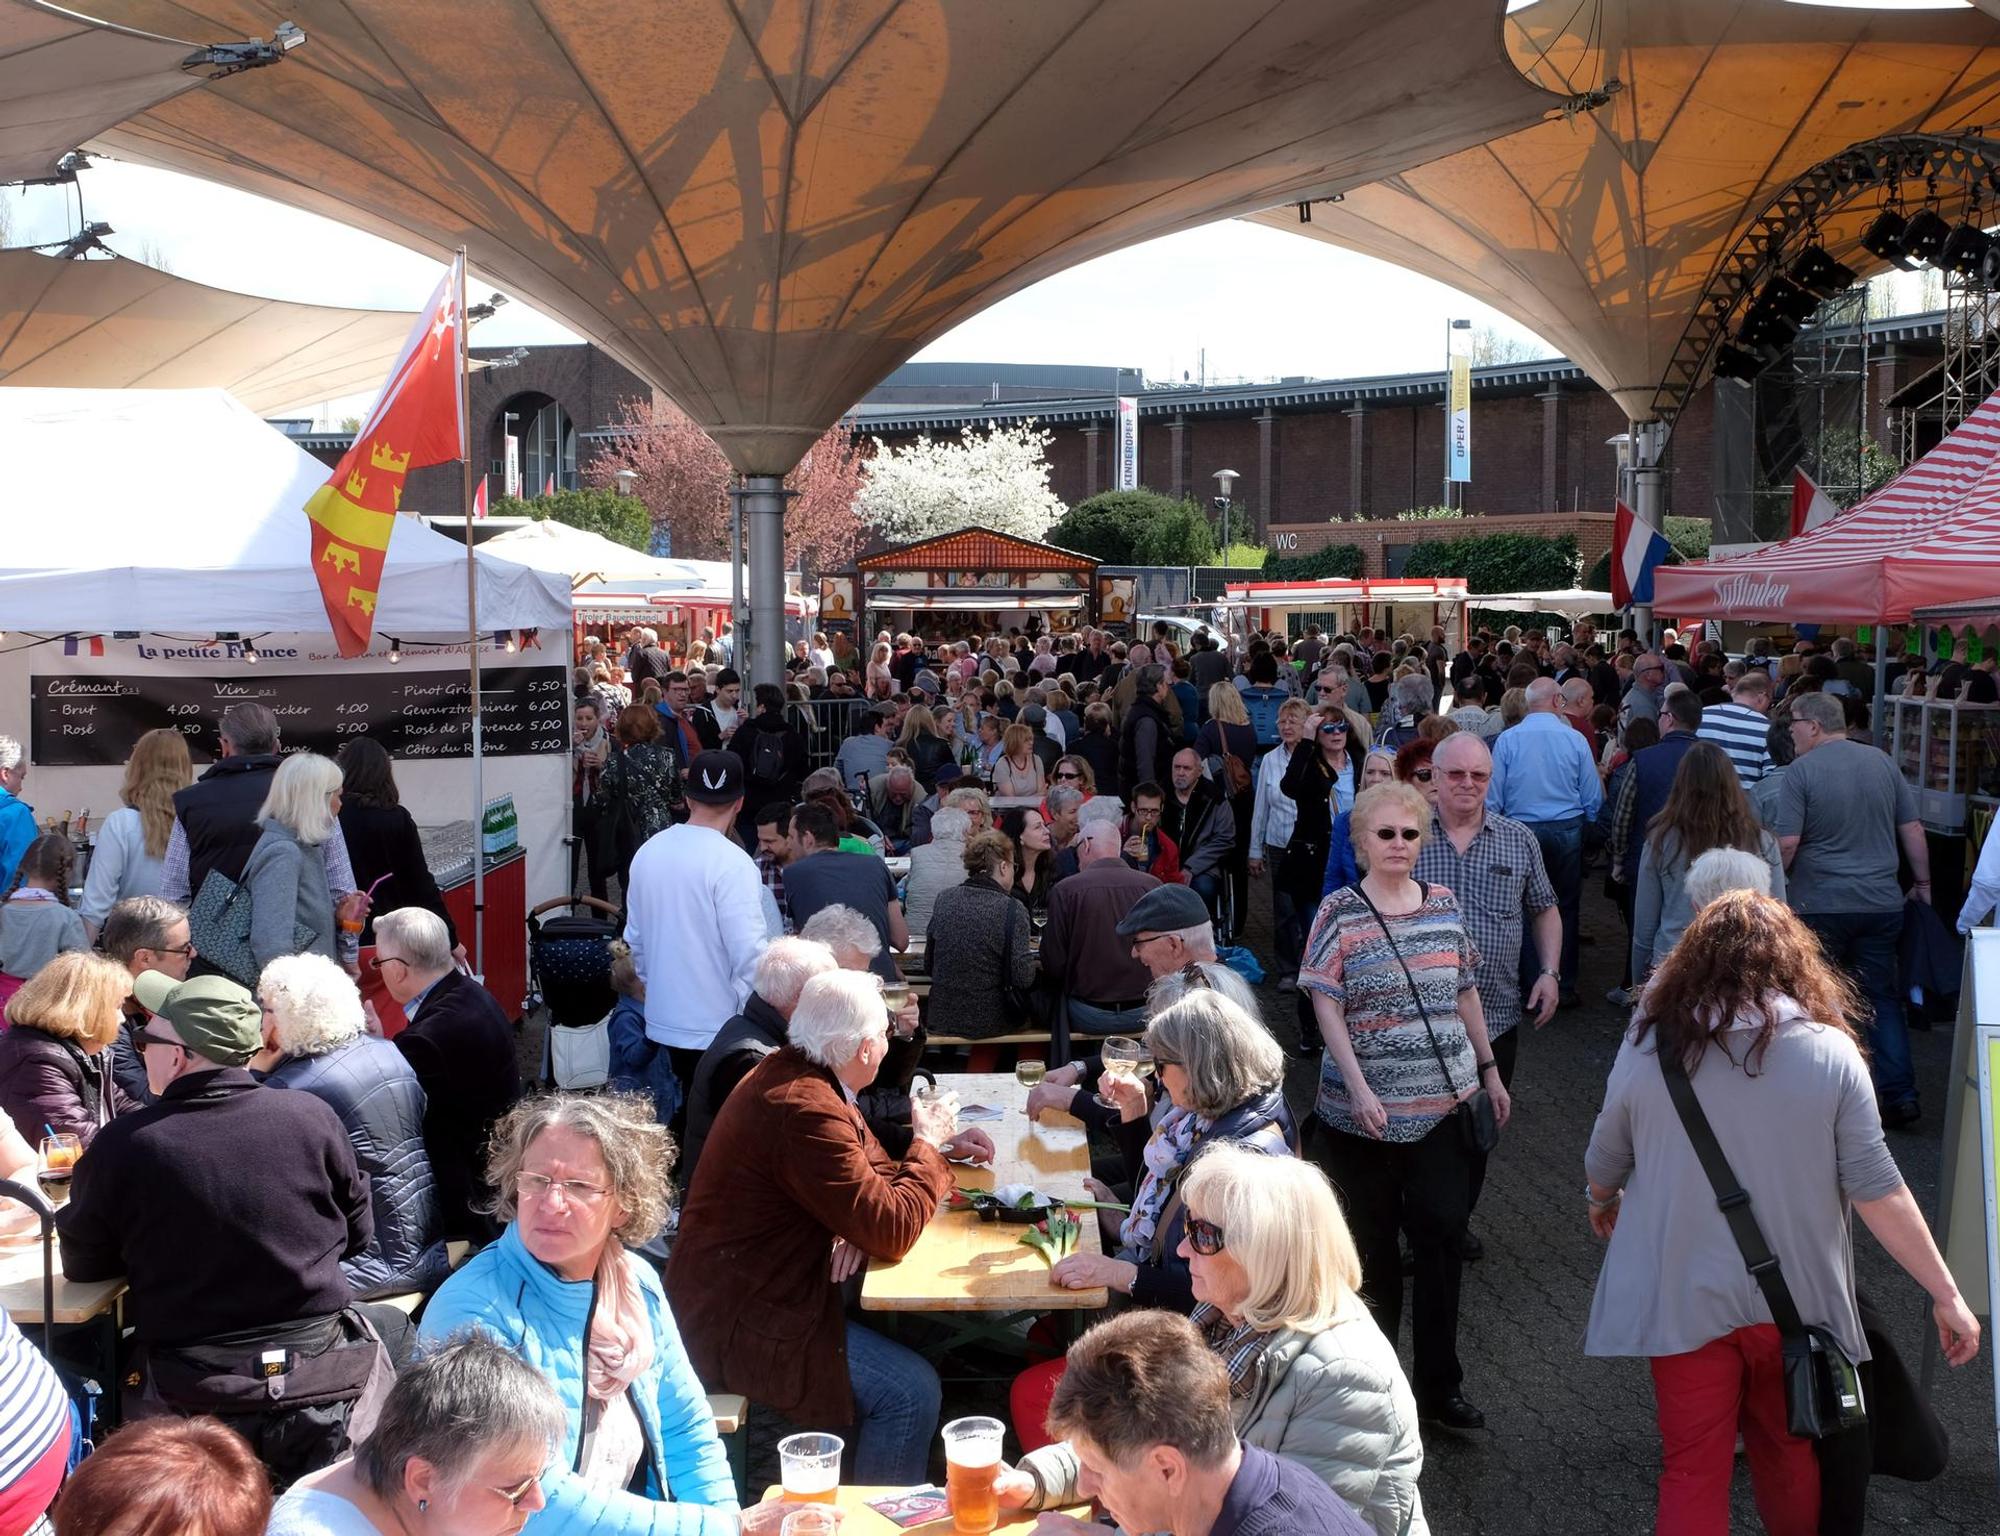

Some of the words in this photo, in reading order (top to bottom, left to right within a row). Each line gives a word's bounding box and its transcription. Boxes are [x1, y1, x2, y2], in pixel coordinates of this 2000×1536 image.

[1457, 424, 1465, 458] OPER
[1124, 418, 1134, 486] KINDEROPER
[1275, 533, 1298, 549] WC
[1712, 572, 1790, 616] Saftladen
[578, 613, 603, 621] Tiroler
[137, 644, 158, 659] La
[163, 645, 220, 660] petite
[308, 652, 329, 661] Bar
[47, 679, 124, 695] Crémant
[213, 683, 250, 695] Vin
[404, 684, 444, 696] Pinot
[528, 680, 561, 692] 5,50
[62, 704, 98, 716] Brut
[166, 704, 200, 716] 4,00
[335, 703, 369, 715] 4,00
[528, 700, 561, 712] 6,00
[62, 723, 96, 736] Rosé
[335, 722, 369, 734] 5,00
[404, 722, 438, 736] Rosé
[440, 721, 458, 734] de
[529, 719, 562, 732] 5,00
[405, 742, 438, 755] Côtes
[440, 741, 462, 753] du
[530, 739, 562, 751] 5,00
